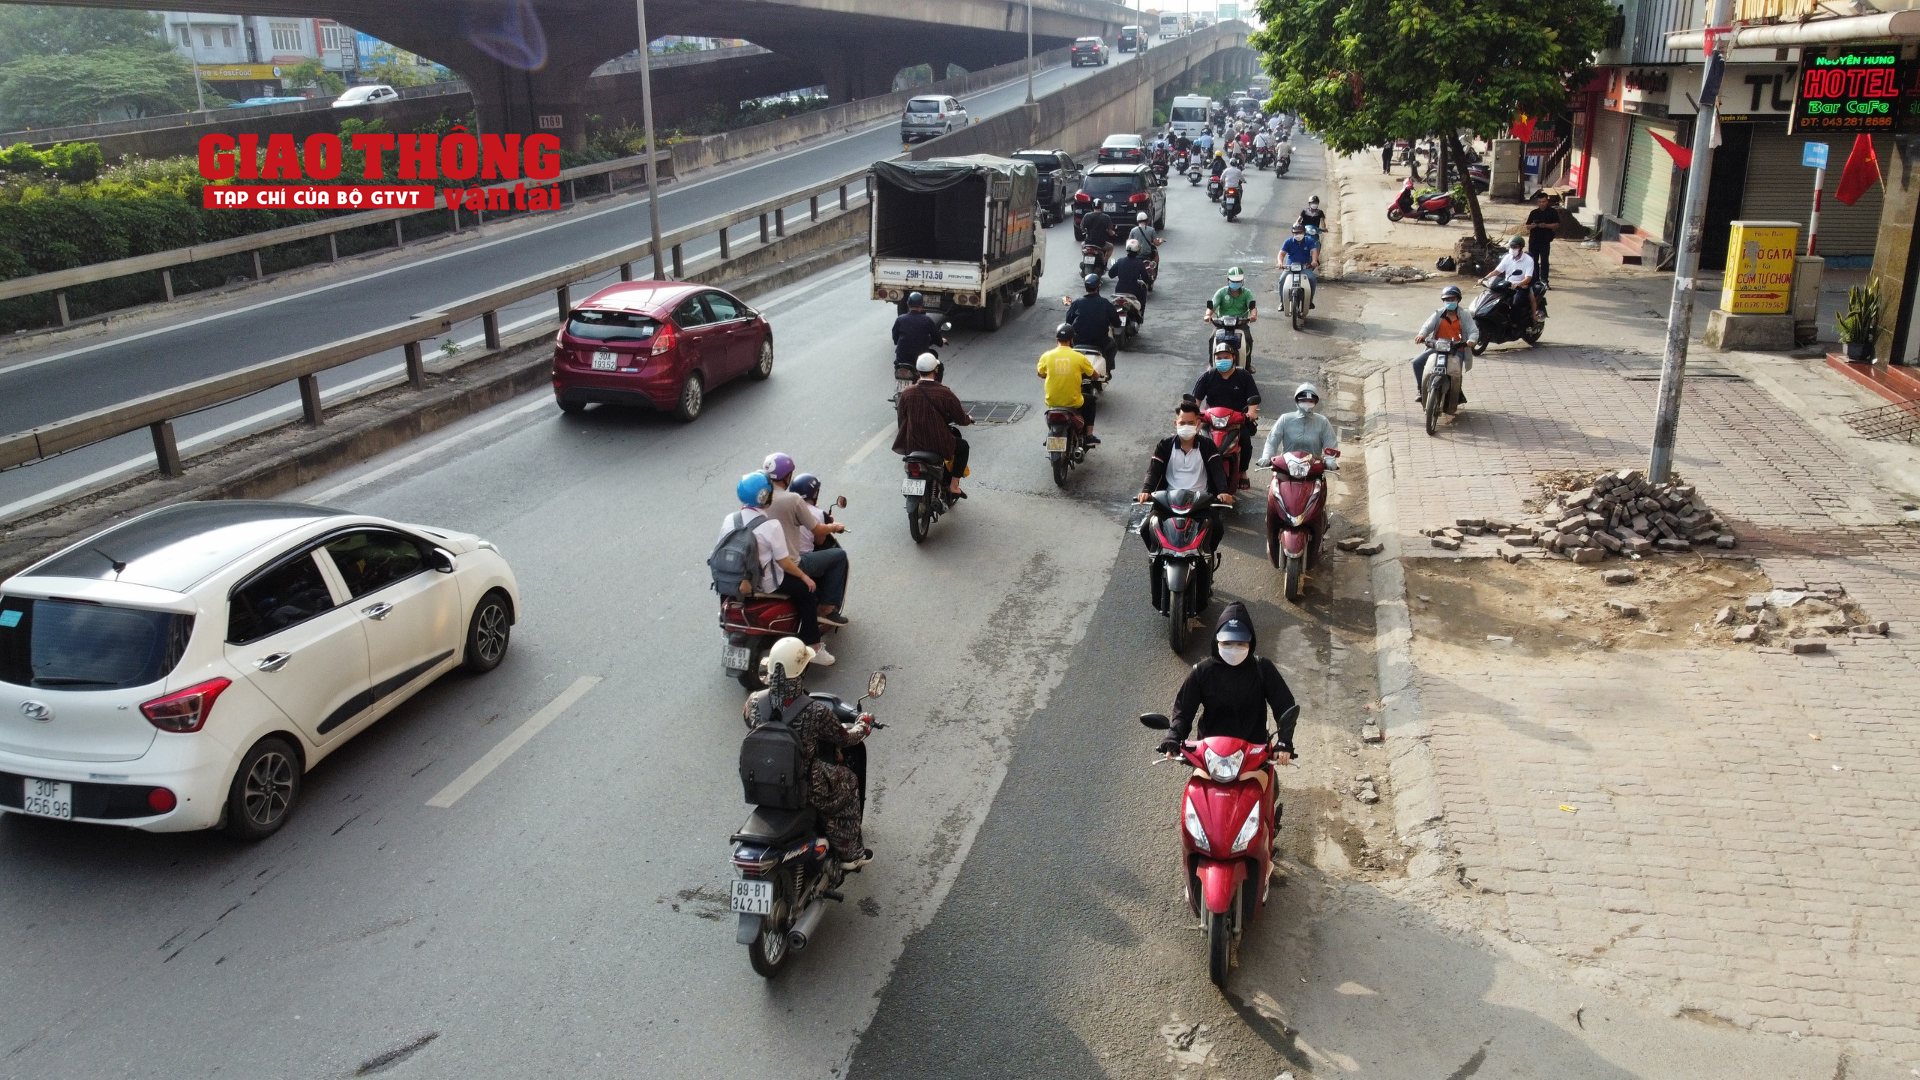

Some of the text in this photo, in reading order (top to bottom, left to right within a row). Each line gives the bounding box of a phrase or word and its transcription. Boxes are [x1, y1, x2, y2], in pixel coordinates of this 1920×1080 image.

[1803, 68, 1899, 98] HOTEL
[1808, 100, 1890, 114] Bar CaFe
[541, 116, 560, 127] T169
[1822, 117, 1843, 127] 043
[906, 269, 943, 280] 29H-173.50
[599, 352, 611, 361] 30A
[594, 360, 615, 370] 193.52
[35, 780, 61, 798] 30F
[26, 796, 70, 818] 256.96
[737, 882, 766, 898] 89-B1
[732, 897, 769, 913] 342.11
